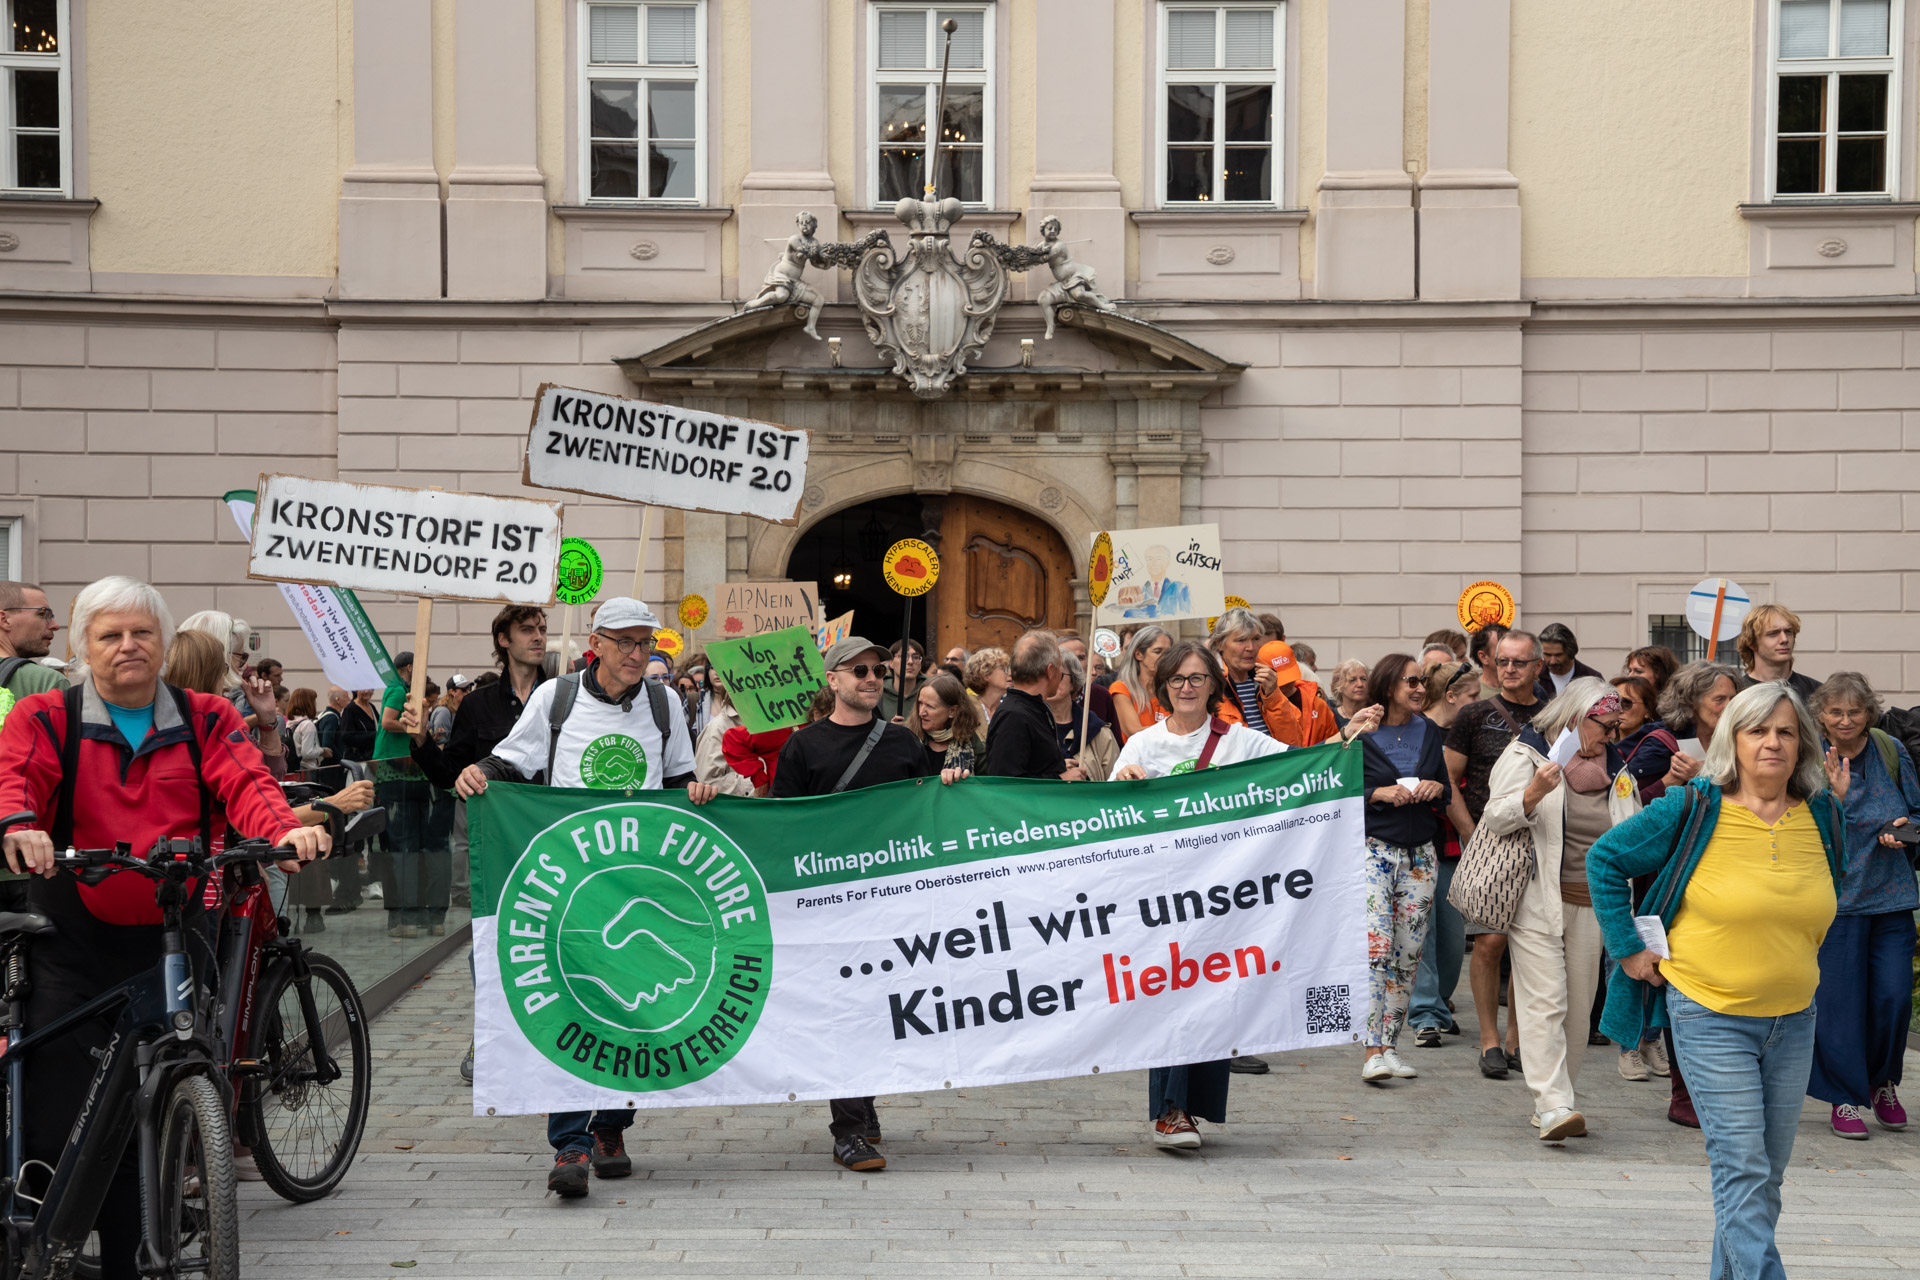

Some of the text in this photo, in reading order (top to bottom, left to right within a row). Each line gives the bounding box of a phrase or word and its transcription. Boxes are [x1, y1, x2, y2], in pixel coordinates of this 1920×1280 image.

[552, 394, 800, 461] KRONSTORF IST
[545, 431, 792, 492] ZWENTENDORF 2.0
[271, 498, 543, 553] KRONSTORF IST
[1188, 537, 1200, 551] in
[265, 534, 537, 585] ZWENTENDORF 2.0
[885, 540, 939, 577] HYPERSCALER?
[885, 571, 934, 596] NEIN DANKE
[1176, 551, 1221, 571] GATSCH
[556, 585, 597, 604] JA BITTE
[722, 646, 814, 693] Kronstorf
[739, 641, 776, 664] Von
[582, 736, 645, 783] PARENTS FOR FUTURE
[793, 766, 1344, 878] Klimapolitik = Friedenspolitik = Zukunftspolitik
[796, 893, 843, 909] Parents
[846, 889, 868, 902] For
[870, 882, 912, 899] Future
[915, 866, 1011, 891] Oberösterreich
[1016, 843, 1155, 875] www.parentsforfuture.at
[1174, 833, 1218, 849] Mitglied
[1220, 831, 1241, 842] von
[1243, 808, 1342, 838] klimaallianz-ooe.at
[509, 817, 757, 1015] PARENTS FOR FUTURE
[1028, 892, 1117, 947] wir
[1138, 868, 1314, 928] unsere
[242, 946, 259, 1033] SIMPLON
[556, 954, 763, 1079] OBERÖSTERREICH
[888, 942, 1283, 1041] Kinder lieben.
[71, 1032, 121, 1145] SIMPLON
